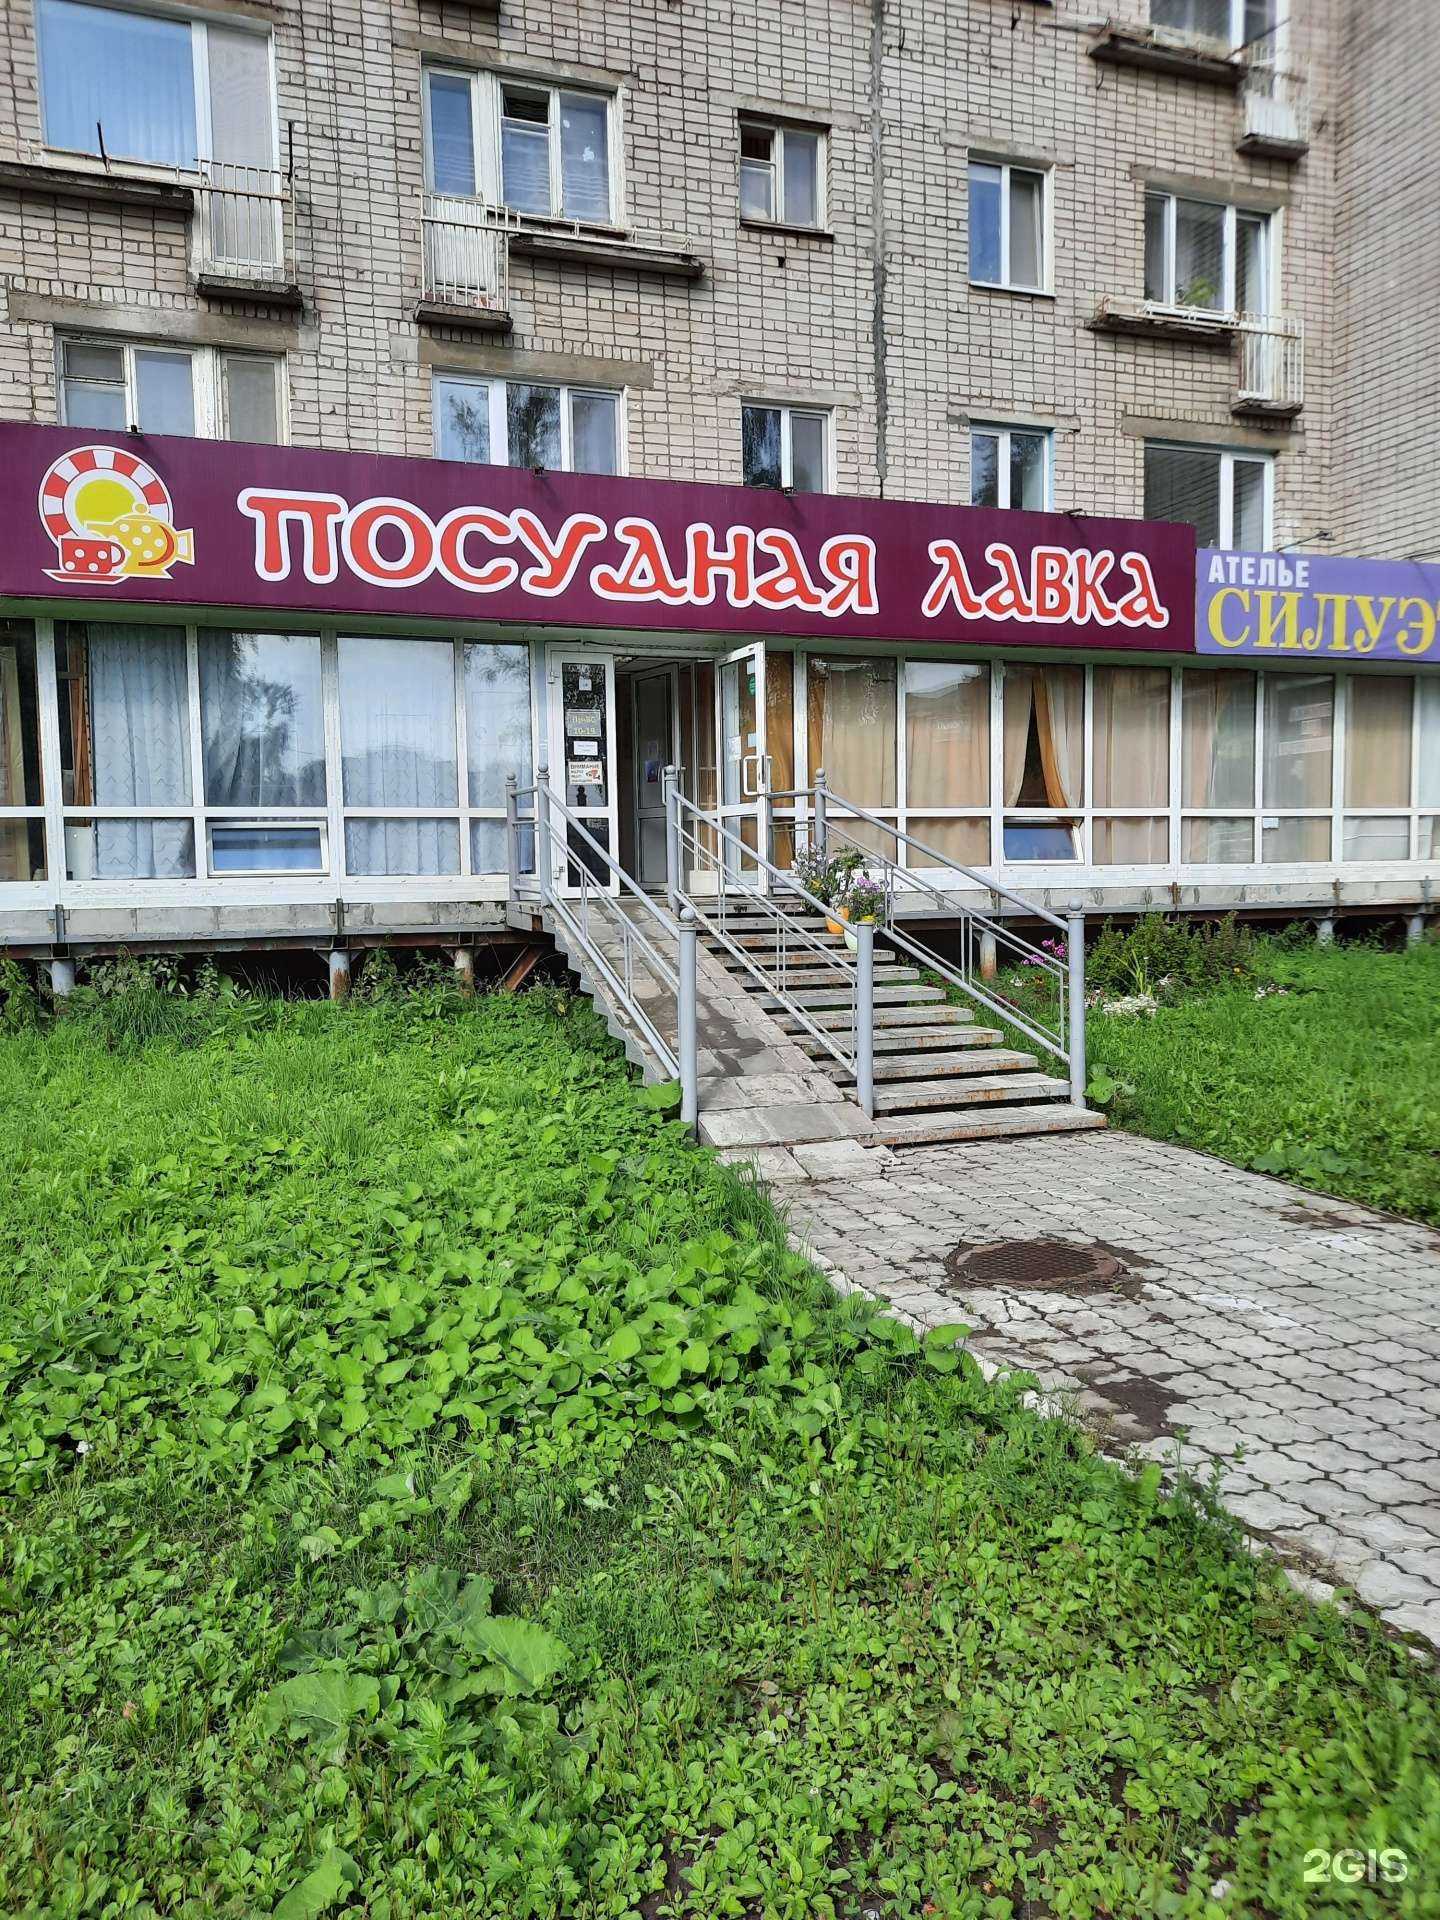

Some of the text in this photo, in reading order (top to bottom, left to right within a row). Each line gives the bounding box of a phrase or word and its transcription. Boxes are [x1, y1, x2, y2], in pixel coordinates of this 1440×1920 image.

[238, 488, 1169, 628] ПОСУДНАЯ ЛАВКА
[1208, 555, 1310, 588] АТЕЛЬЕ
[1208, 587, 1440, 655] СИЛУЭ
